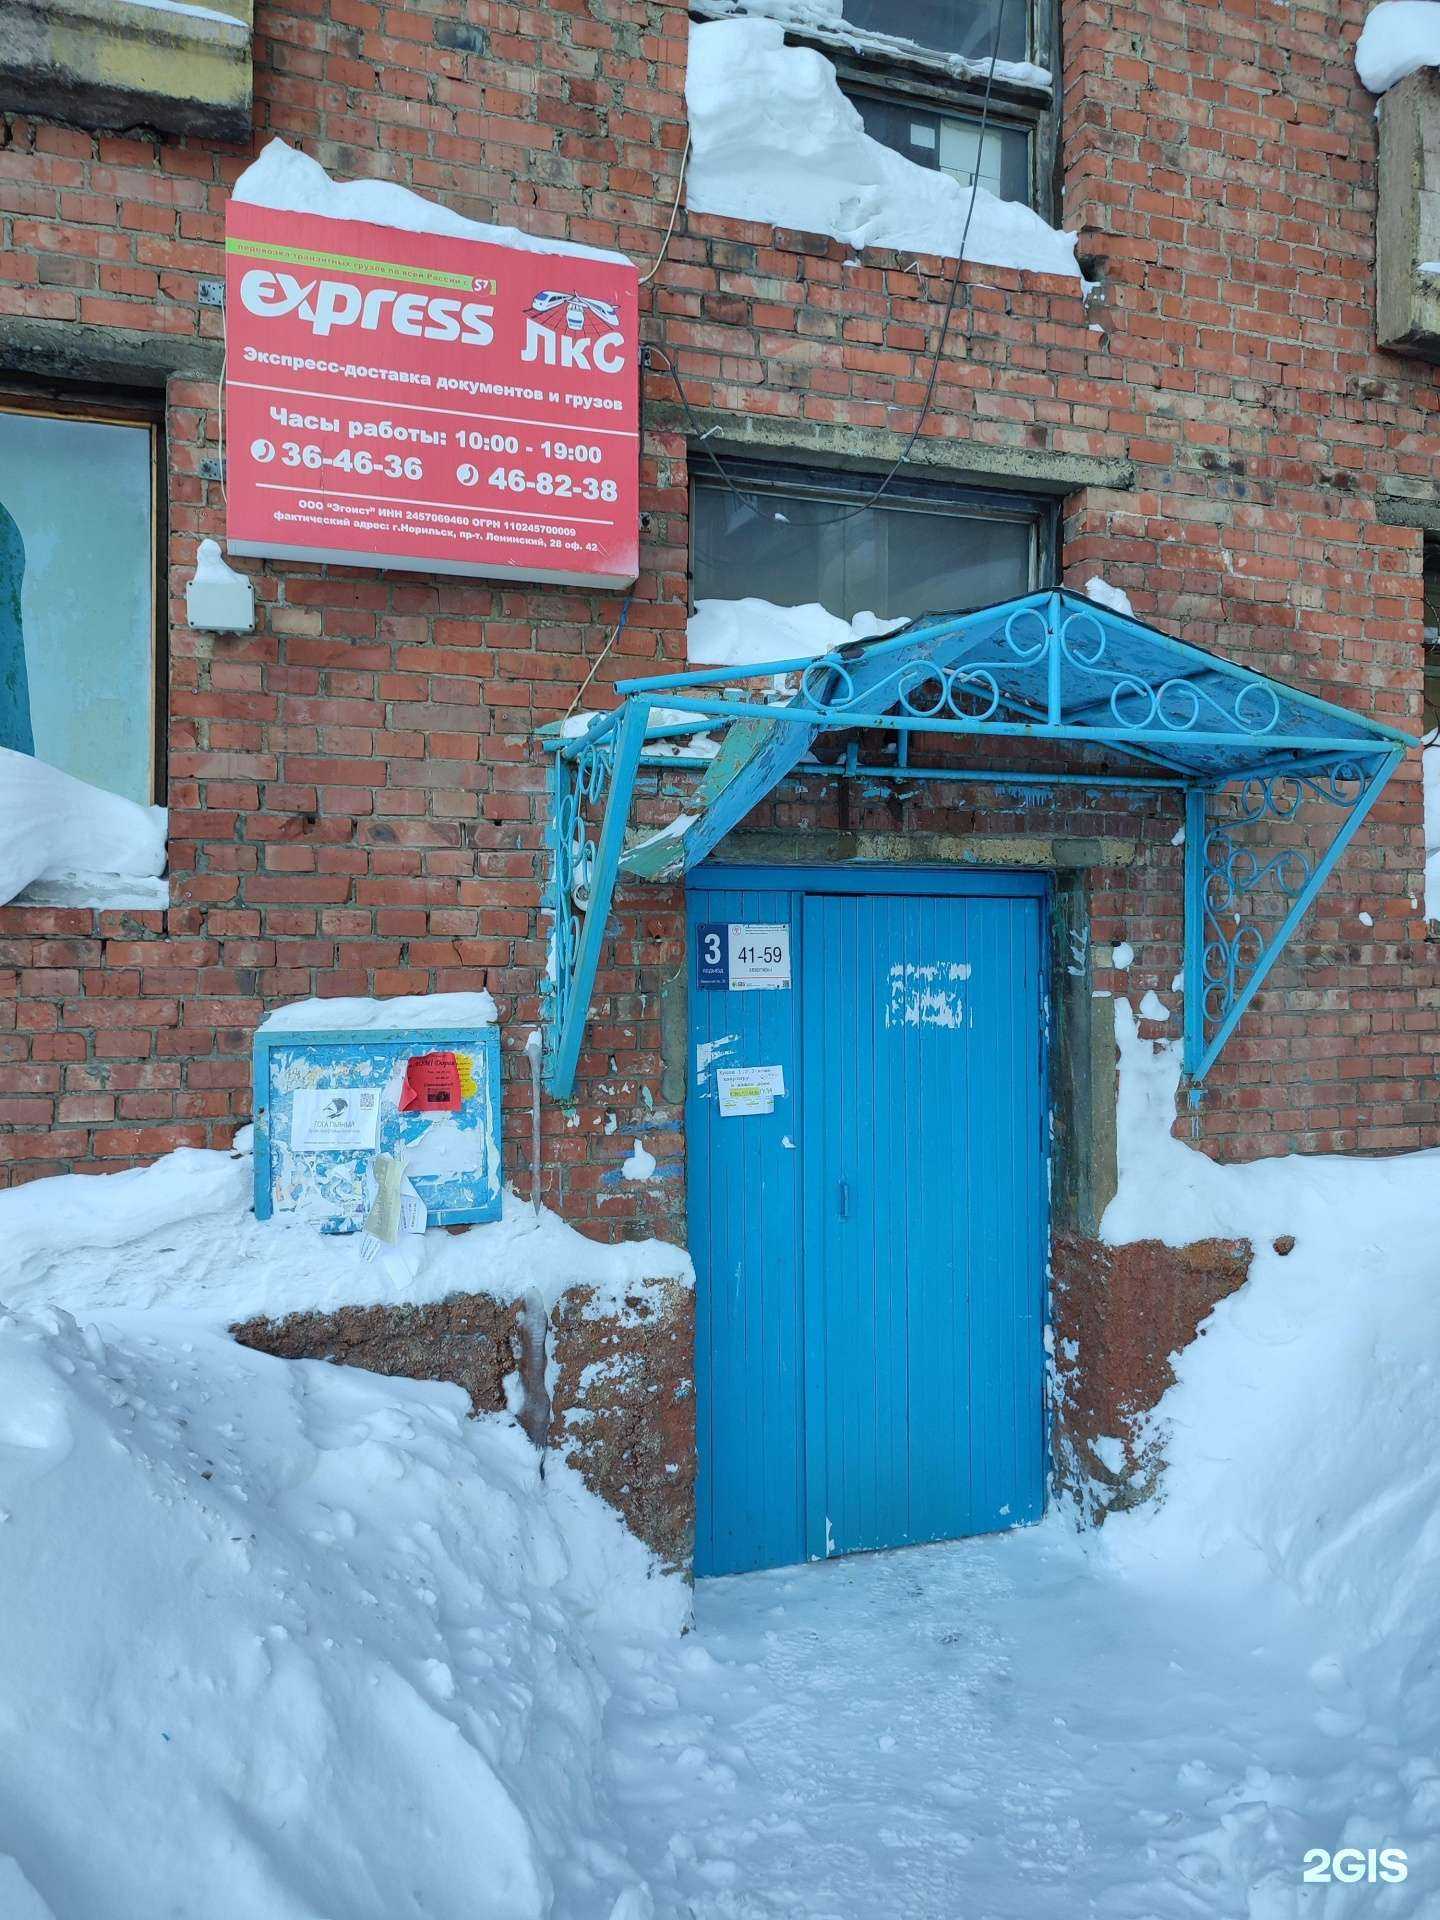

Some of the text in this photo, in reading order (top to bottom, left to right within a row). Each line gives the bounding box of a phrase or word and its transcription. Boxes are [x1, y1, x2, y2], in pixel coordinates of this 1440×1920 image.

[353, 262, 386, 274] грузов
[426, 273, 462, 286] России
[473, 278, 490, 292] S7
[243, 346, 623, 411] Экспресс-доставка документов и грузов
[270, 405, 340, 433] Часы
[348, 420, 447, 446] работы:
[455, 430, 519, 454] 10:00
[540, 440, 602, 464] 19:00
[281, 441, 423, 481] 36-46-36
[488, 467, 618, 502] 46-82-38
[298, 499, 324, 511] ООО
[378, 508, 403, 519] ИНН
[472, 517, 501, 529] ОГРН
[273, 510, 351, 527] фактический
[353, 521, 390, 531] адрес:
[392, 523, 457, 538] г.Норильск,
[486, 532, 547, 548] Ленинский,
[564, 541, 583, 551] оф.
[585, 543, 598, 552] 42
[704, 933, 721, 965] 3
[738, 946, 782, 964] 41-59
